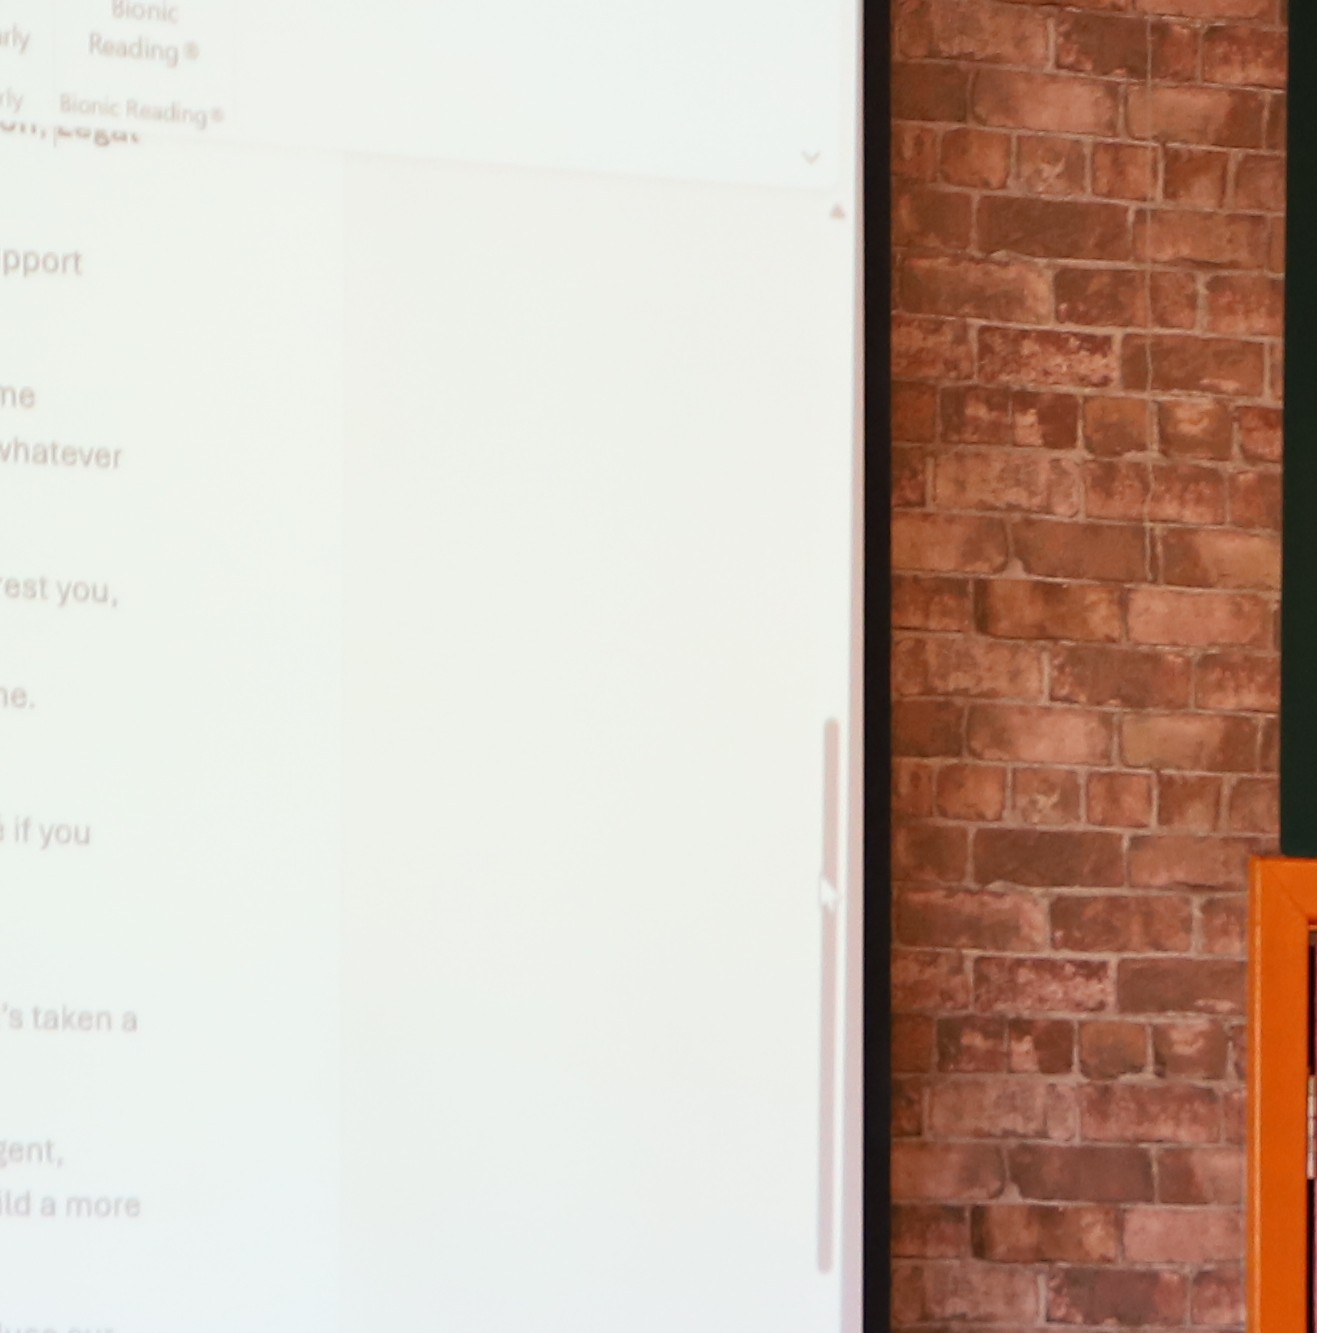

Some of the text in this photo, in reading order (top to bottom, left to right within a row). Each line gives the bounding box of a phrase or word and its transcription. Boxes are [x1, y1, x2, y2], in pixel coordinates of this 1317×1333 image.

[112, 0, 180, 24] Bionic
[59, 93, 121, 118] Bionic
[0, 575, 48, 601] est
[14, 813, 32, 844] if
[39, 822, 91, 850] you
[32, 1005, 113, 1032] taken
[120, 1010, 138, 1032] a
[40, 1195, 57, 1217] a
[65, 1196, 143, 1219] more
